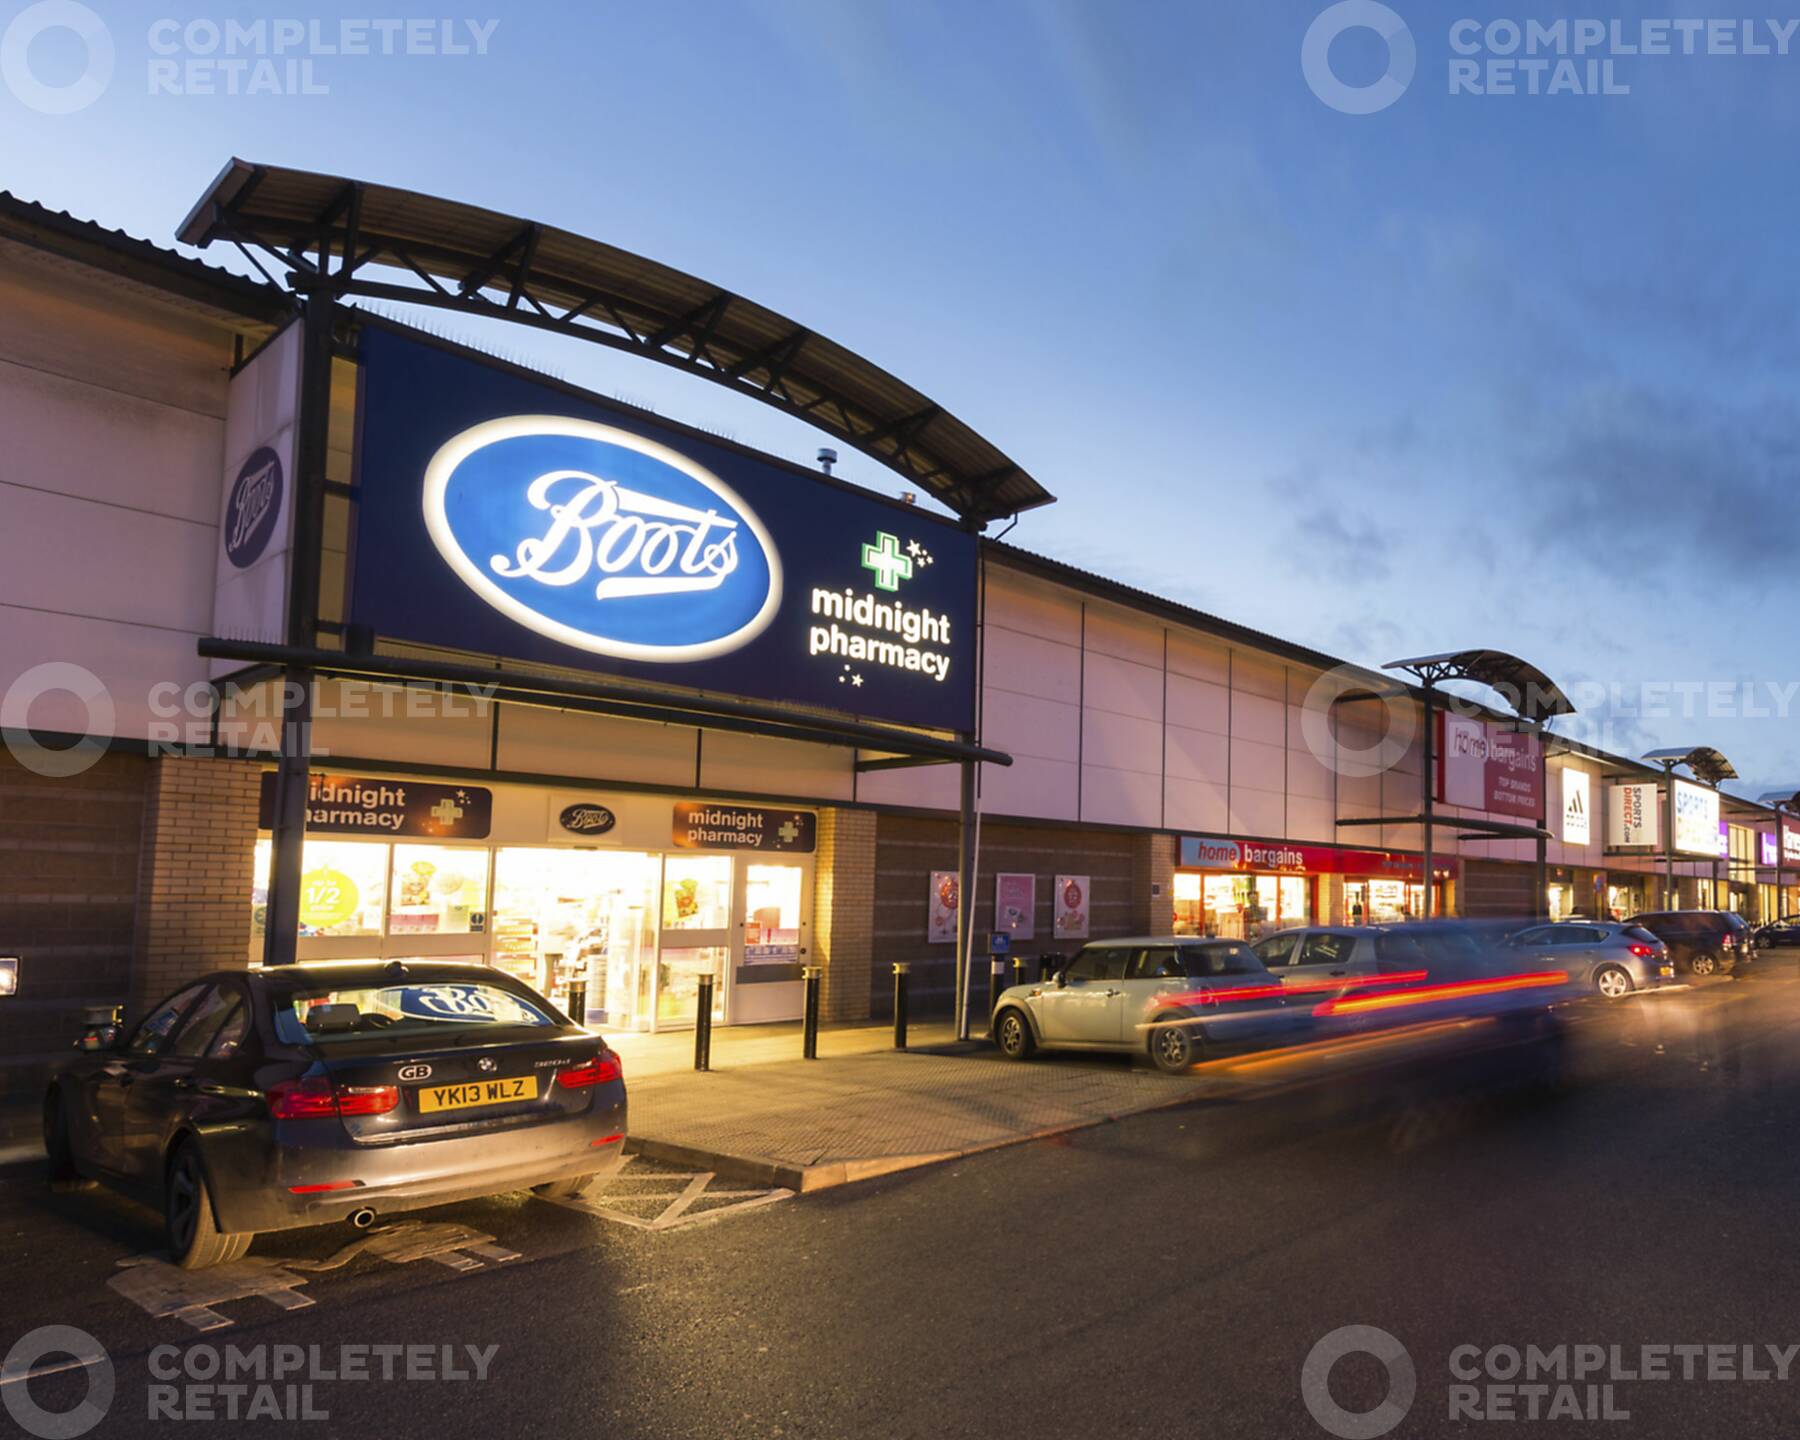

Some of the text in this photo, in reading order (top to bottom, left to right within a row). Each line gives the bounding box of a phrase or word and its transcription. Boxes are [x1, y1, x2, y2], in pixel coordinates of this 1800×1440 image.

[228, 461, 275, 552] Boots
[490, 470, 738, 600] Boots
[811, 588, 951, 645] midnight
[809, 624, 950, 682] pharmacy
[1455, 727, 1537, 772] home bargains
[309, 783, 406, 809] idnight
[1632, 787, 1642, 829] SPORTS
[306, 808, 405, 830] armacy
[566, 809, 610, 830] Boots
[688, 809, 763, 829] midnight
[688, 826, 763, 846] pharmacy
[1198, 841, 1303, 868] home bargains
[306, 887, 341, 904] 1/2
[401, 1066, 430, 1079] GB
[433, 1080, 525, 1107] YK13 WLZ
